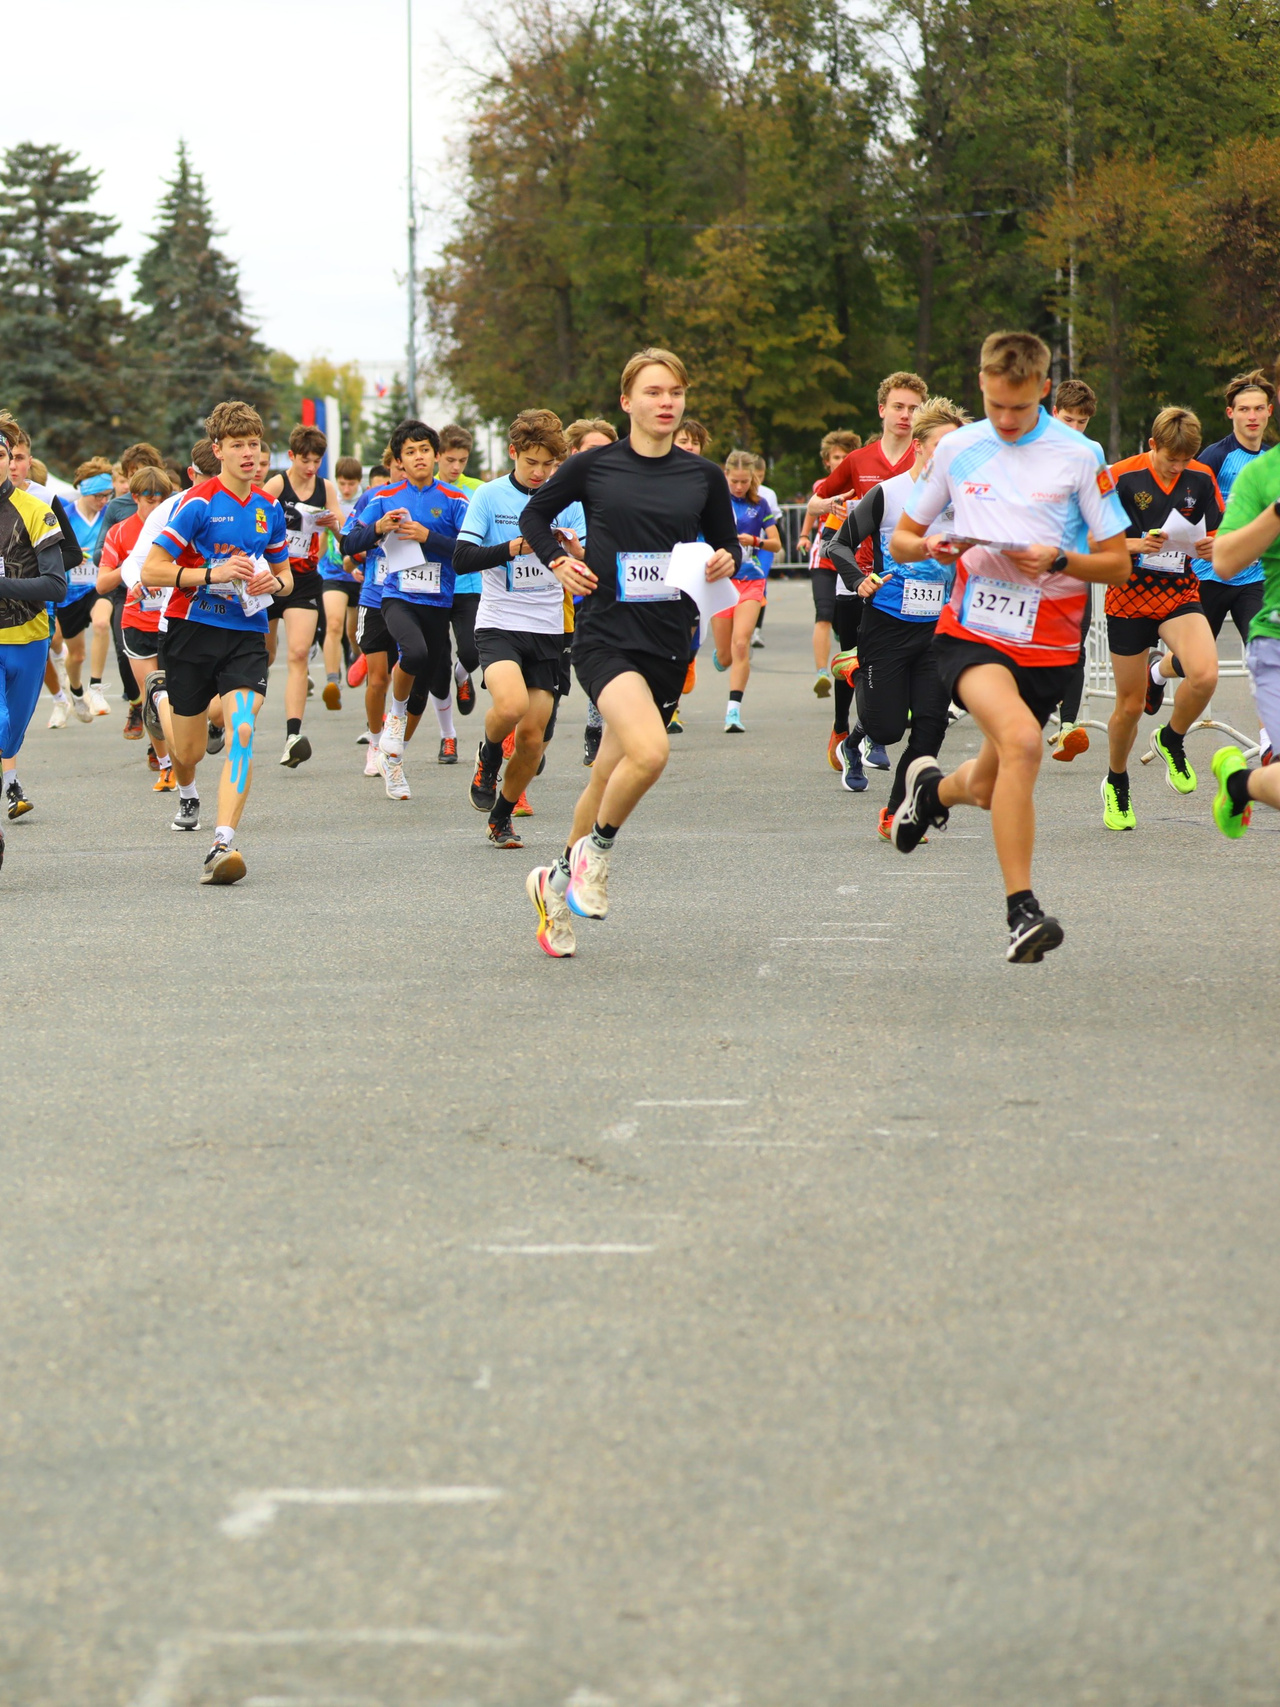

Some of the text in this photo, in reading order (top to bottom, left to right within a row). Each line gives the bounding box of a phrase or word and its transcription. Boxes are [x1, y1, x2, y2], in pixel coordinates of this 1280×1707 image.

[72, 568, 95, 576] 331.1
[403, 569, 433, 581] 354.1
[515, 566, 543, 579] 310.
[626, 566, 664, 582] 308.
[910, 588, 941, 602] 333.1
[214, 604, 226, 615] 18
[972, 591, 1025, 617] 327.1
